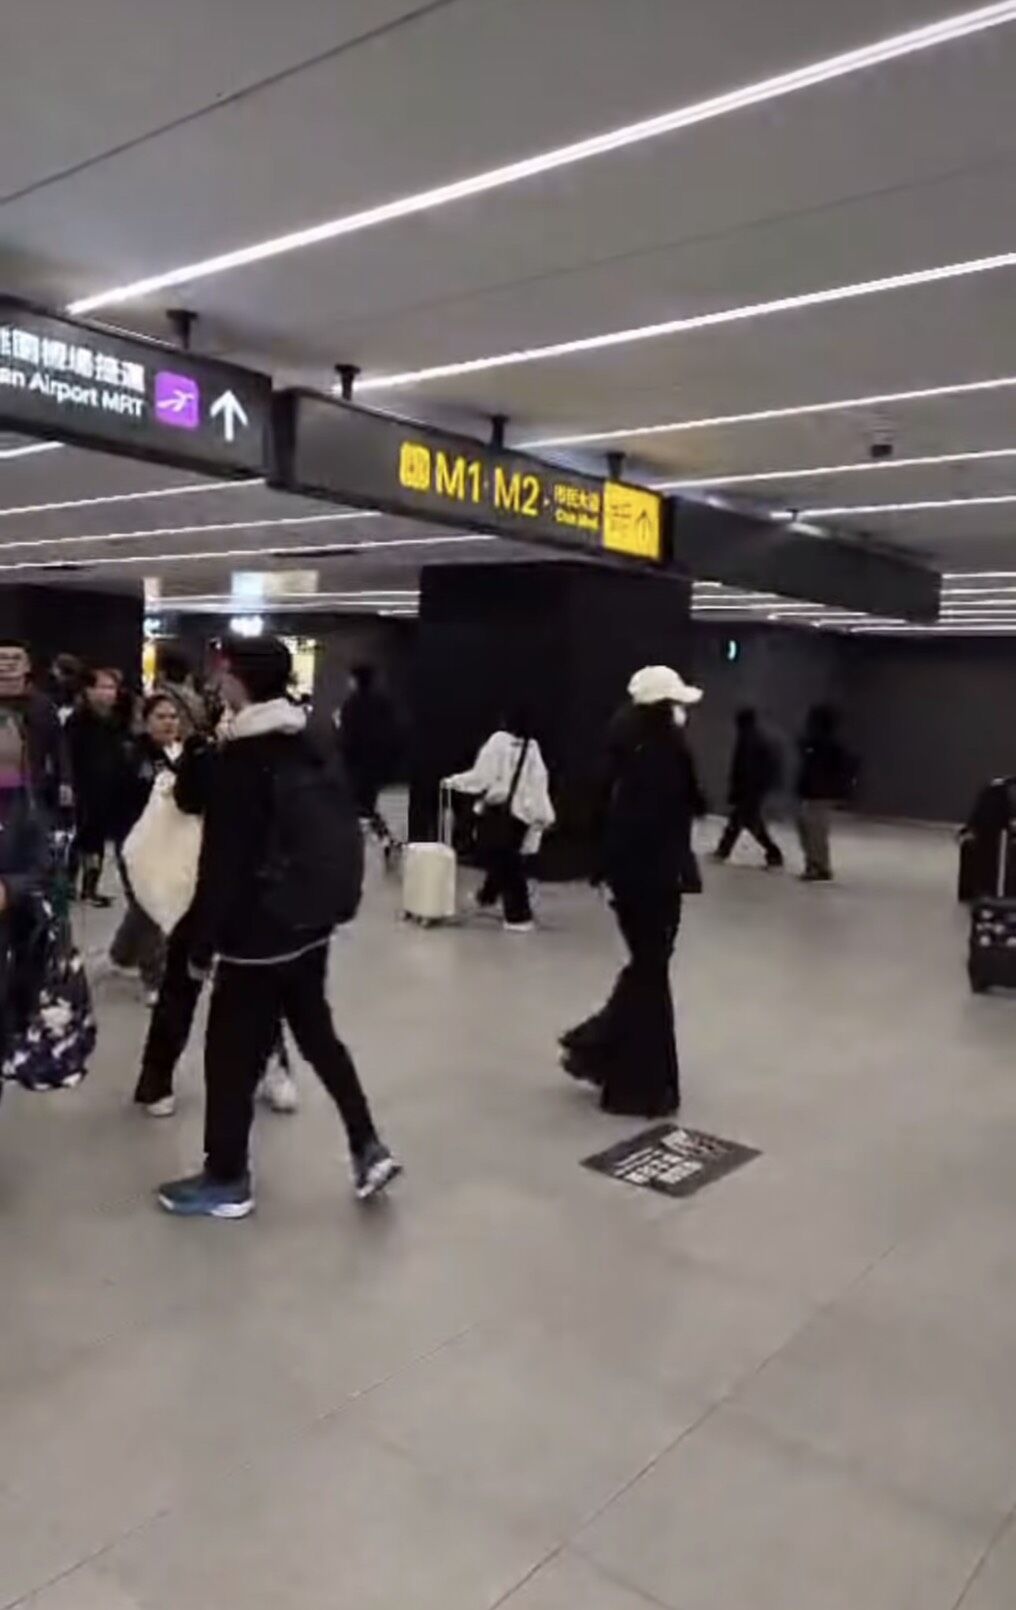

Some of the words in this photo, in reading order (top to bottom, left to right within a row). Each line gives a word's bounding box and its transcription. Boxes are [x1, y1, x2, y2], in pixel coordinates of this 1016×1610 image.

[28, 371, 98, 408] Airport
[102, 390, 145, 417] MRT
[435, 451, 483, 505] M1
[494, 466, 541, 517] M2
